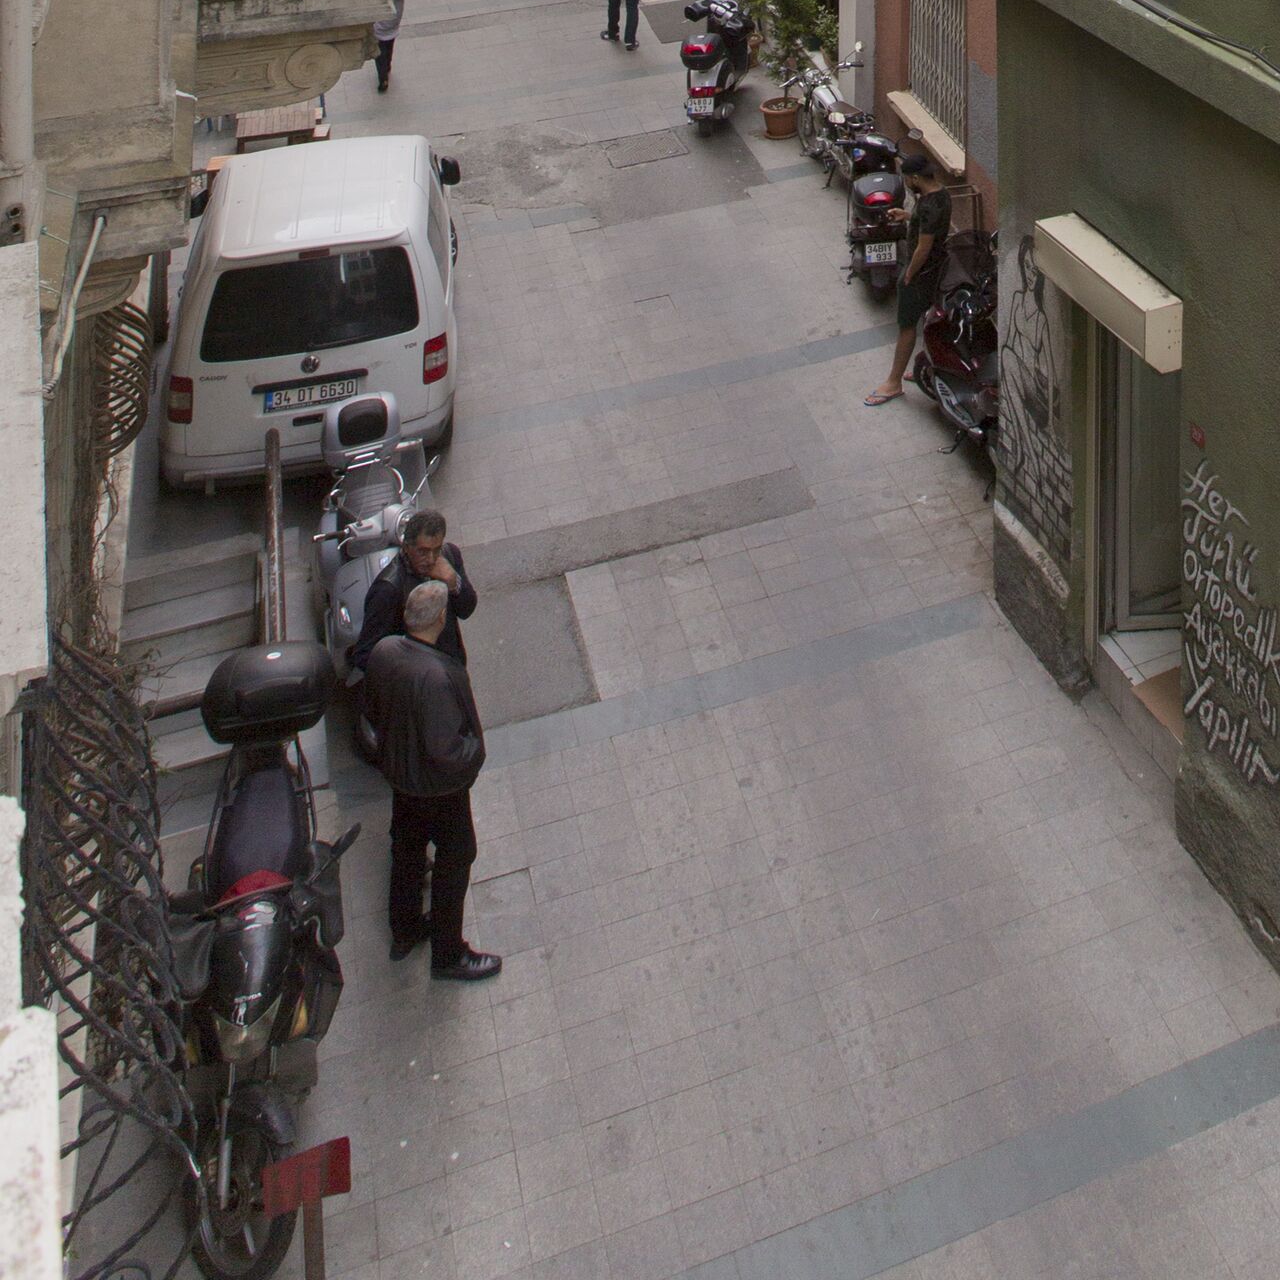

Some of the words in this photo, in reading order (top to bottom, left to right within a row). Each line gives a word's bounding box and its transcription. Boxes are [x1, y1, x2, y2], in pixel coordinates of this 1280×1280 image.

[867, 243, 893, 254] 34BIY
[876, 252, 893, 262] 933
[274, 390, 291, 406] 34
[320, 380, 354, 399] 6630
[1183, 460, 1250, 526] Her
[1181, 498, 1260, 601] Türlü
